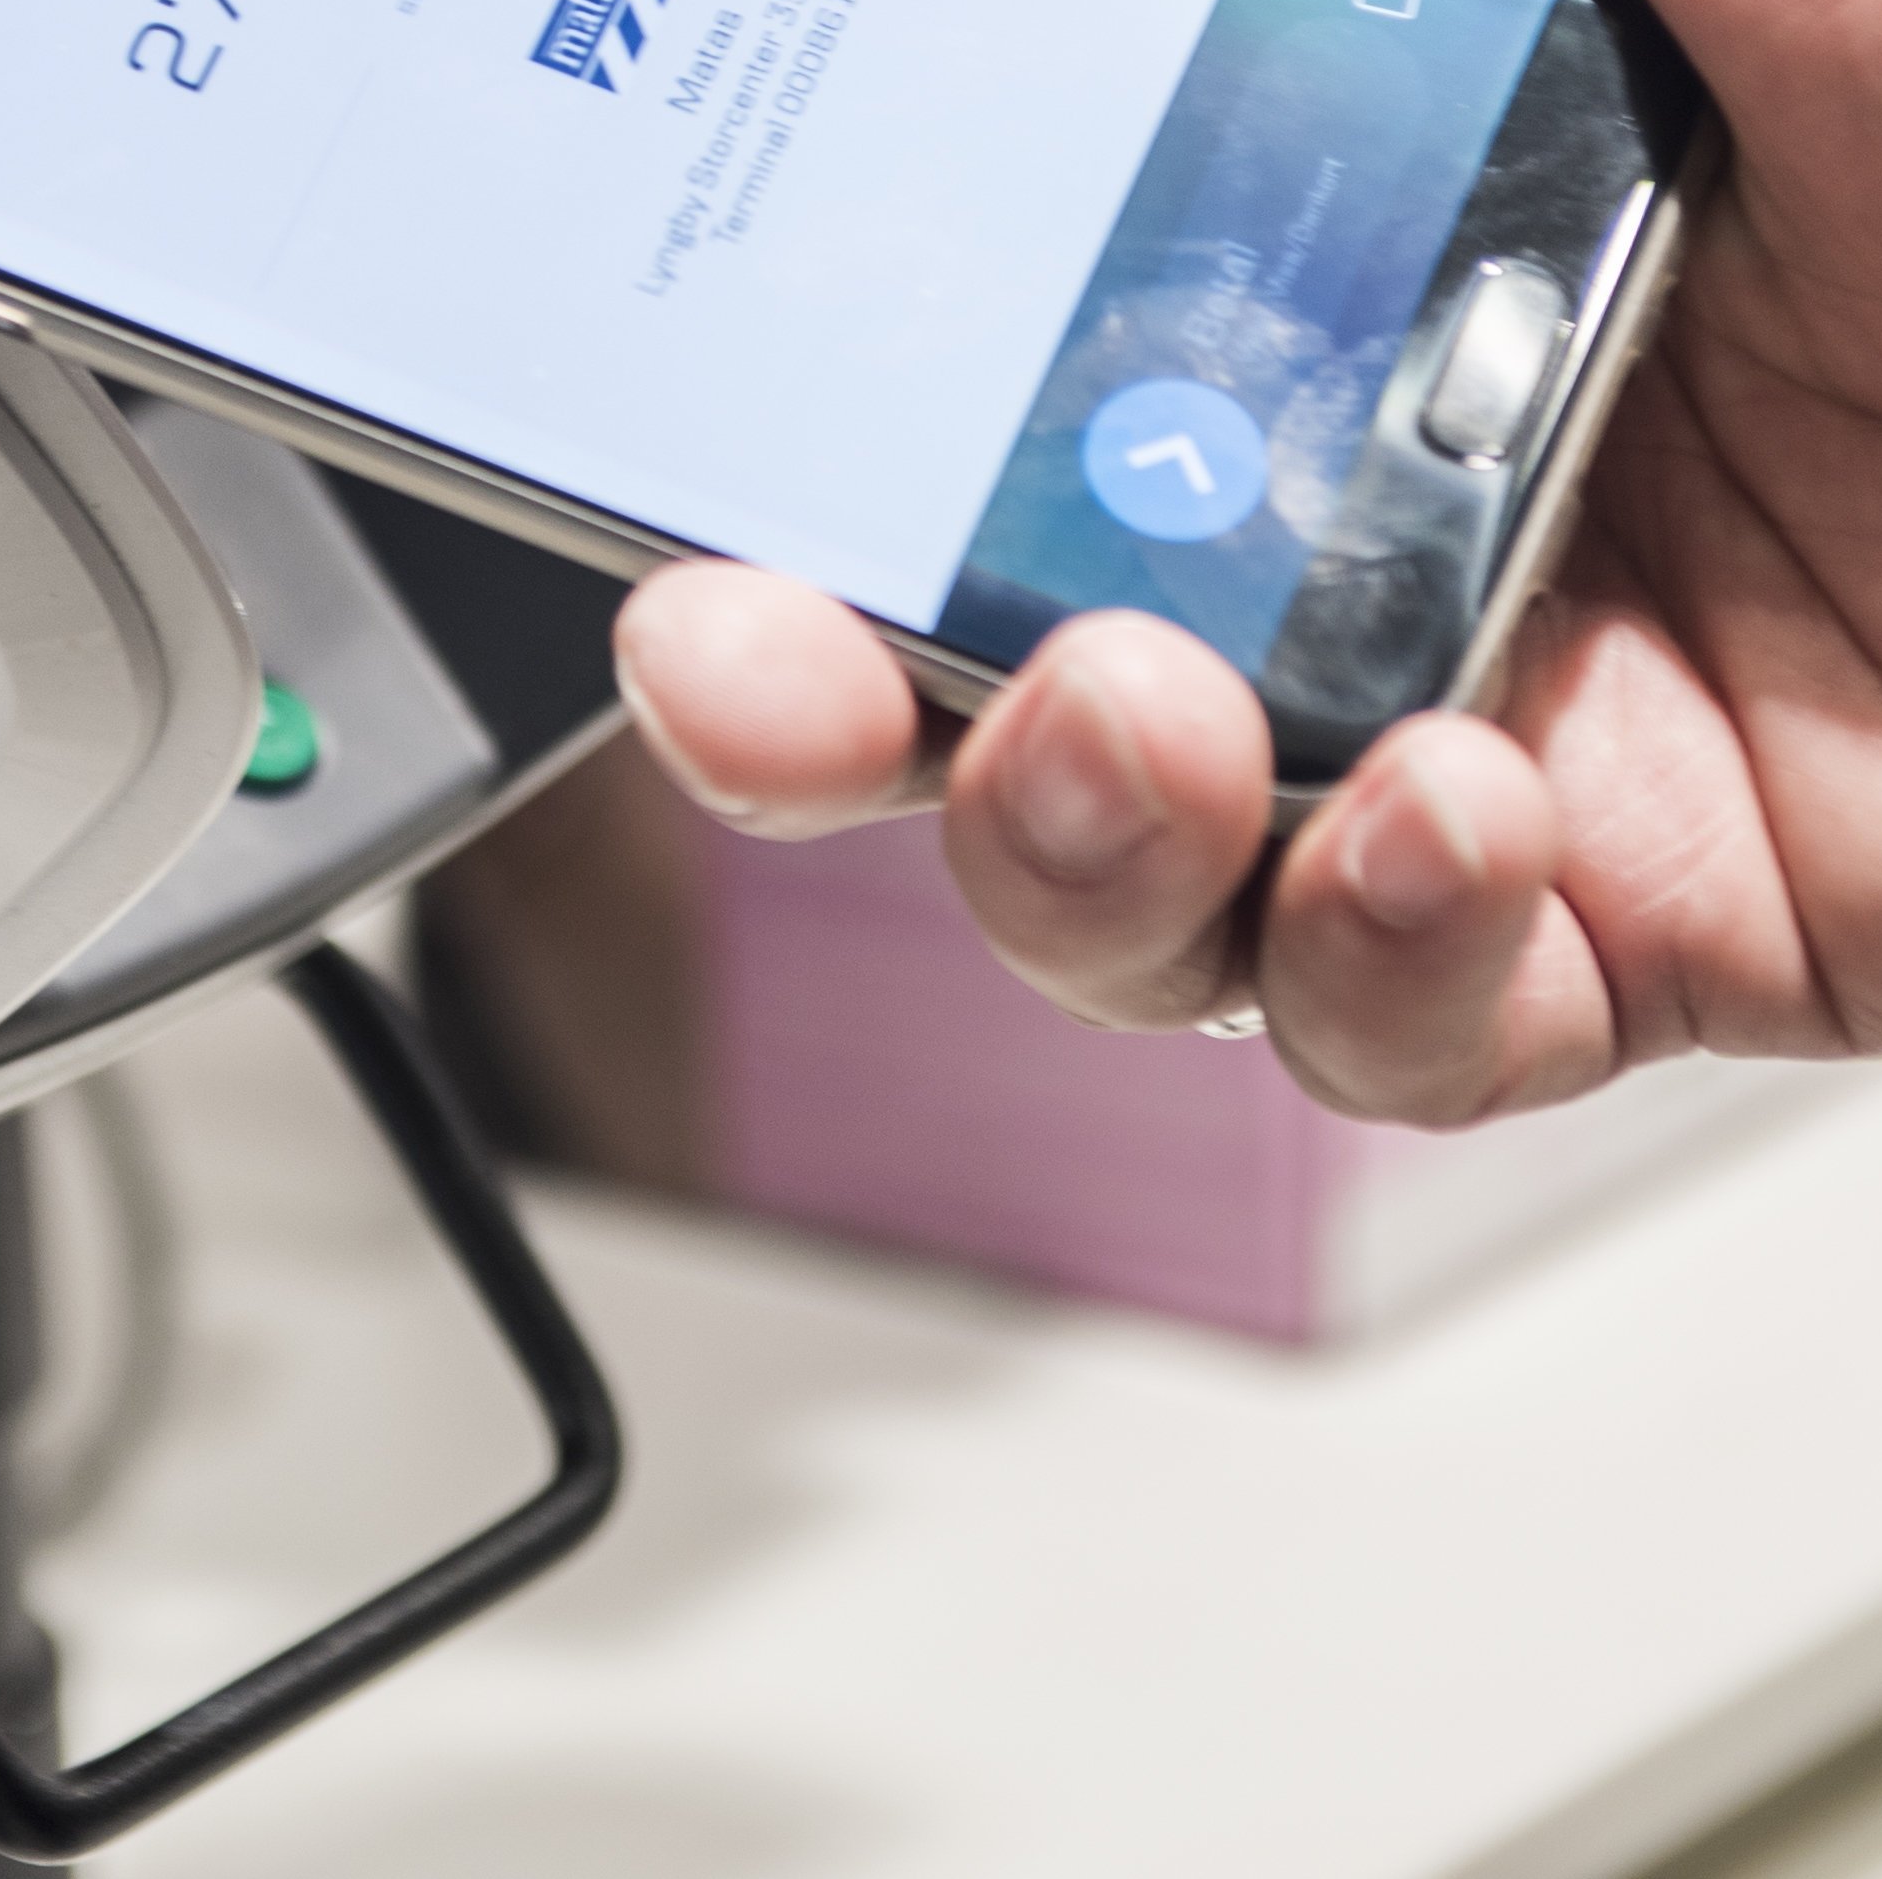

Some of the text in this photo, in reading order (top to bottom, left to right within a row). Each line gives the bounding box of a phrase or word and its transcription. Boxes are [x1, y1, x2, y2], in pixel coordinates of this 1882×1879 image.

[665, 8, 746, 117] Matas
[632, 191, 713, 300] Lyngby
[684, 28, 786, 192] Storcenter
[709, 118, 794, 245] Terminal
